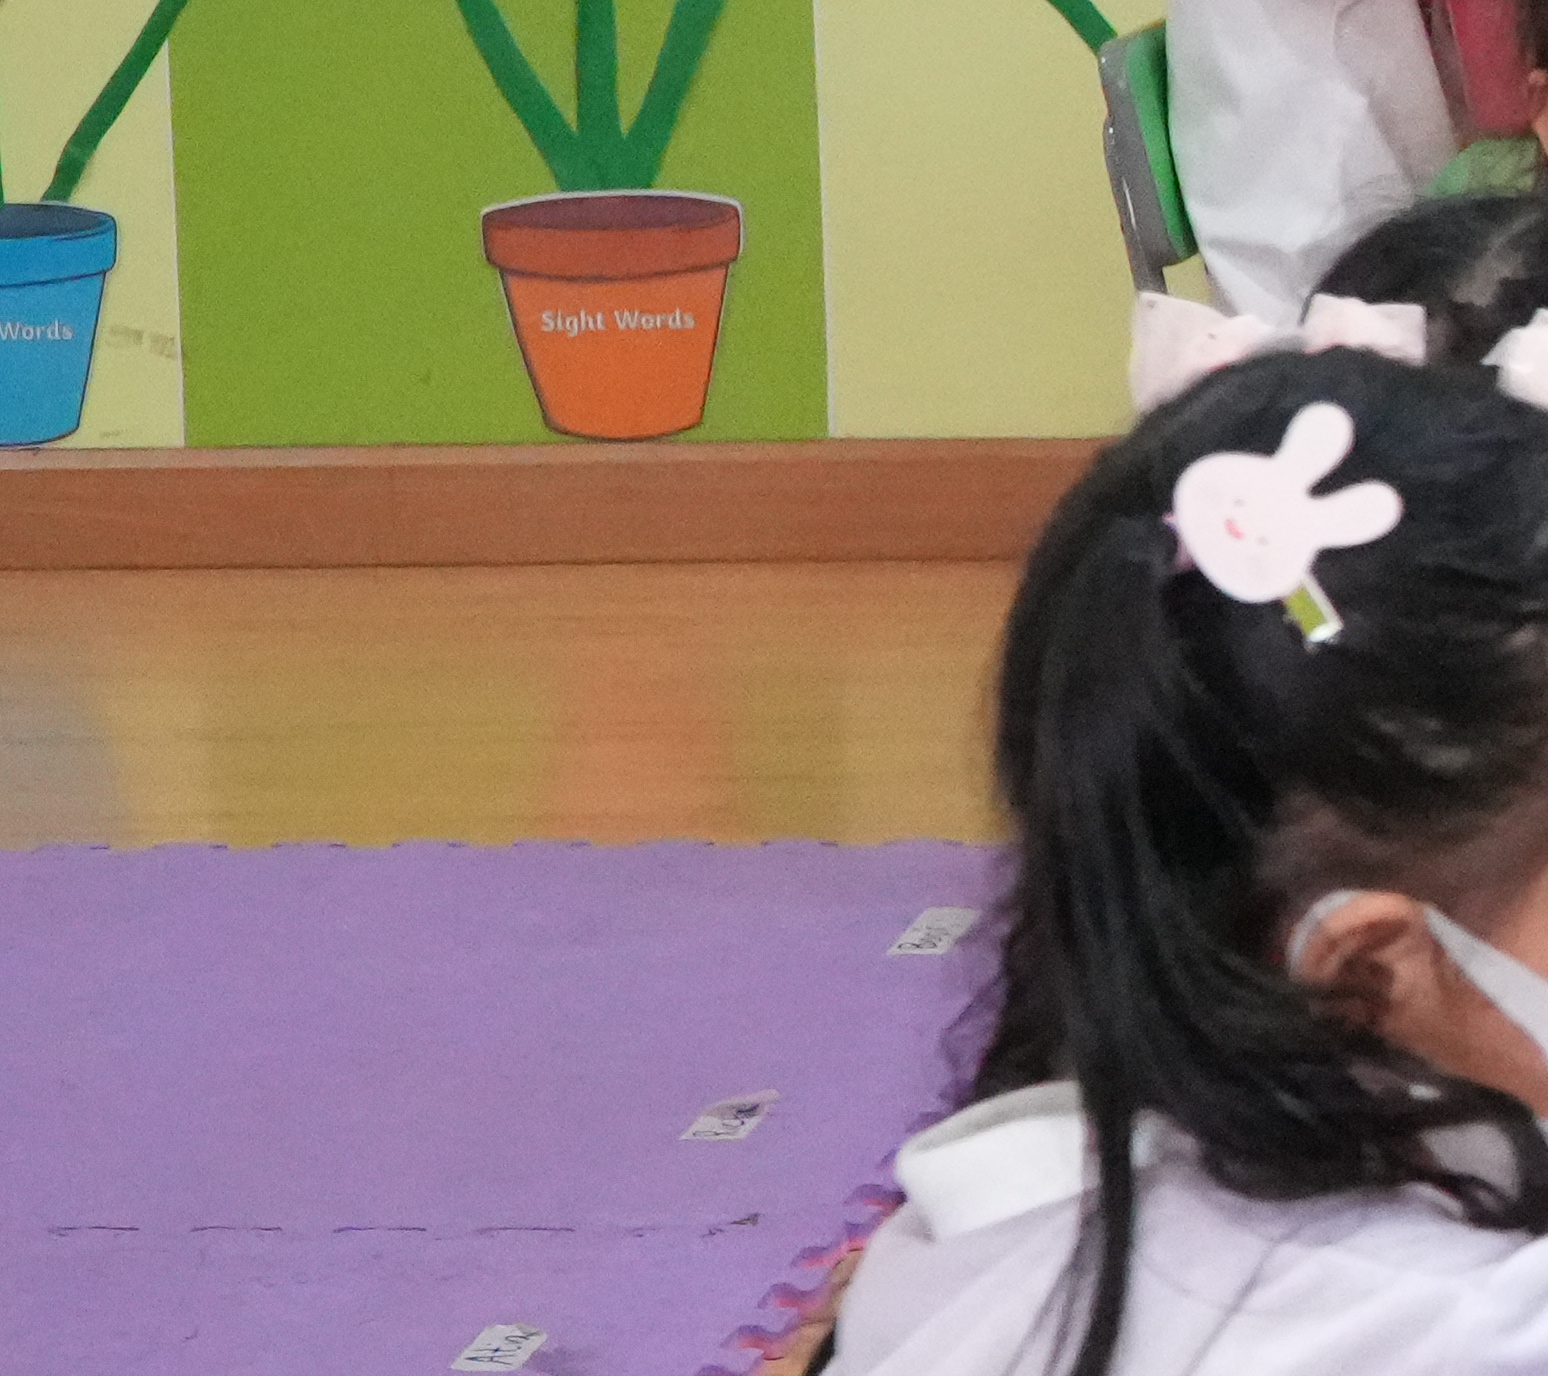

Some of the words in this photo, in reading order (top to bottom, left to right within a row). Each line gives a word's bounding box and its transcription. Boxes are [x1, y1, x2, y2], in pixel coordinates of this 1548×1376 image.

[0, 318, 74, 341] Words
[541, 309, 607, 338] Sight
[613, 307, 696, 331] Words
